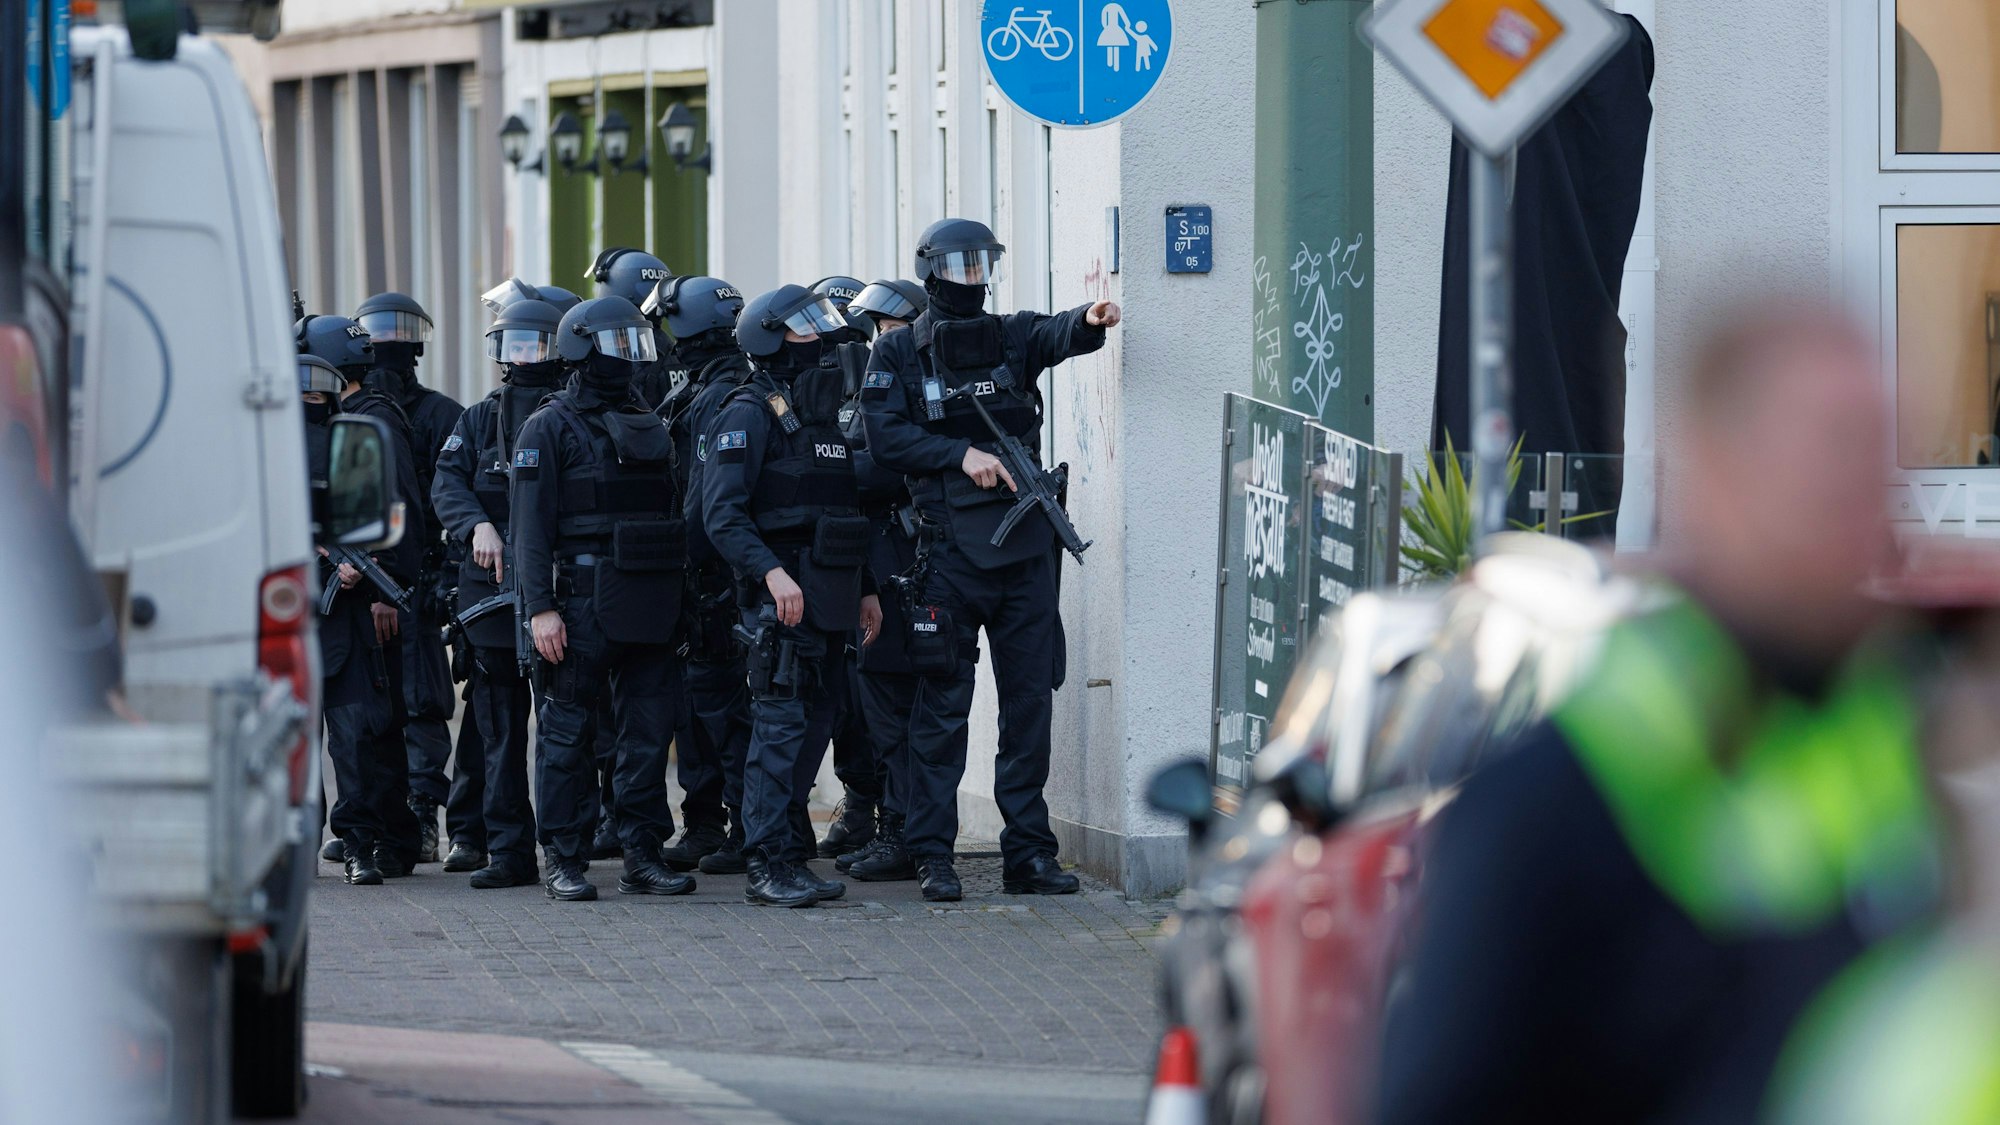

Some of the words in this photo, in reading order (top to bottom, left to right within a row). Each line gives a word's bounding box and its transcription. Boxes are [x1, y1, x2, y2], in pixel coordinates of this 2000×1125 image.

[1192, 225, 1209, 235] 100
[641, 268, 670, 280] POLIZE
[828, 287, 860, 300] POLIZE
[815, 443, 846, 459] POLIZEI
[914, 622, 938, 632] POLIZEI
